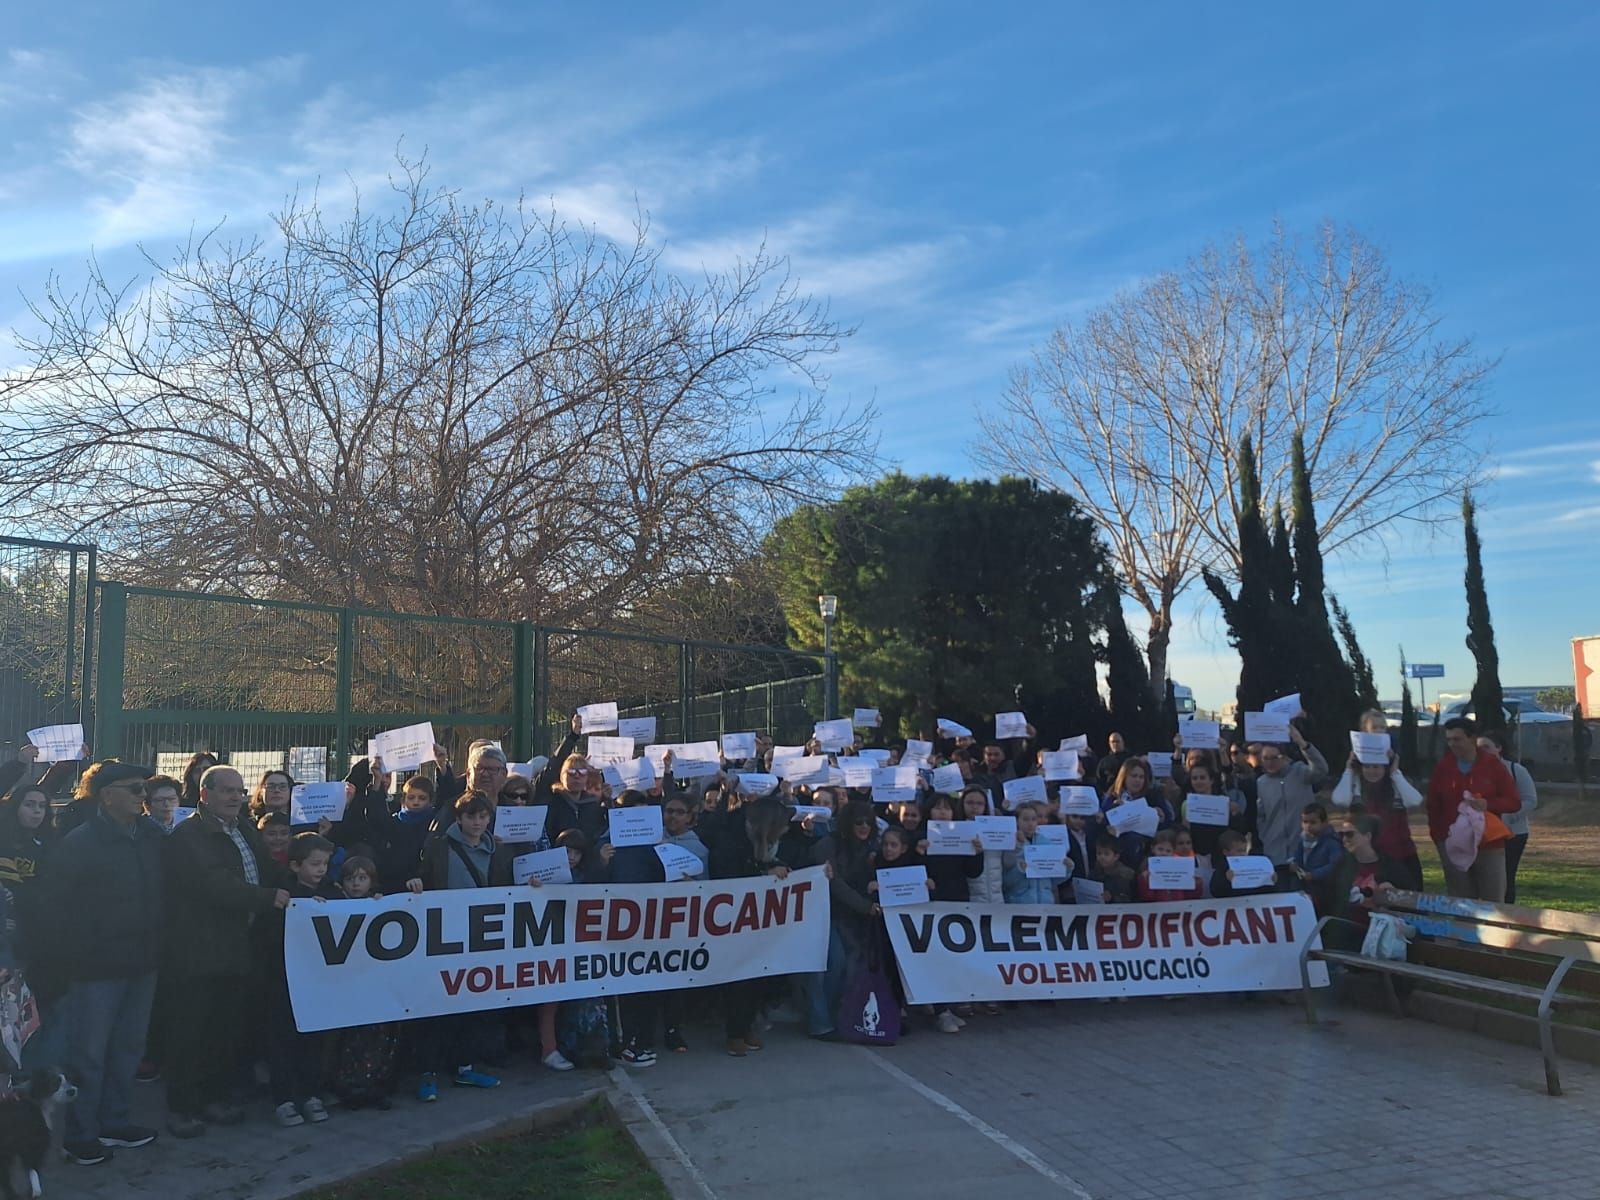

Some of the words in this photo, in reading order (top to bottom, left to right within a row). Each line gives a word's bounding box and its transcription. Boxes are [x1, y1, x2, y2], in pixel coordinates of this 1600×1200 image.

[311, 900, 567, 966] VOLEM
[574, 881, 812, 943] EDIFICANT
[899, 913, 1089, 953] VOLEM
[1095, 906, 1297, 950] EDIFICANT
[440, 958, 566, 996] VOLEM
[574, 942, 710, 981] EDUCACIÓ
[997, 962, 1097, 985] VOLEM
[1100, 952, 1210, 982] EDUCACIÓ
